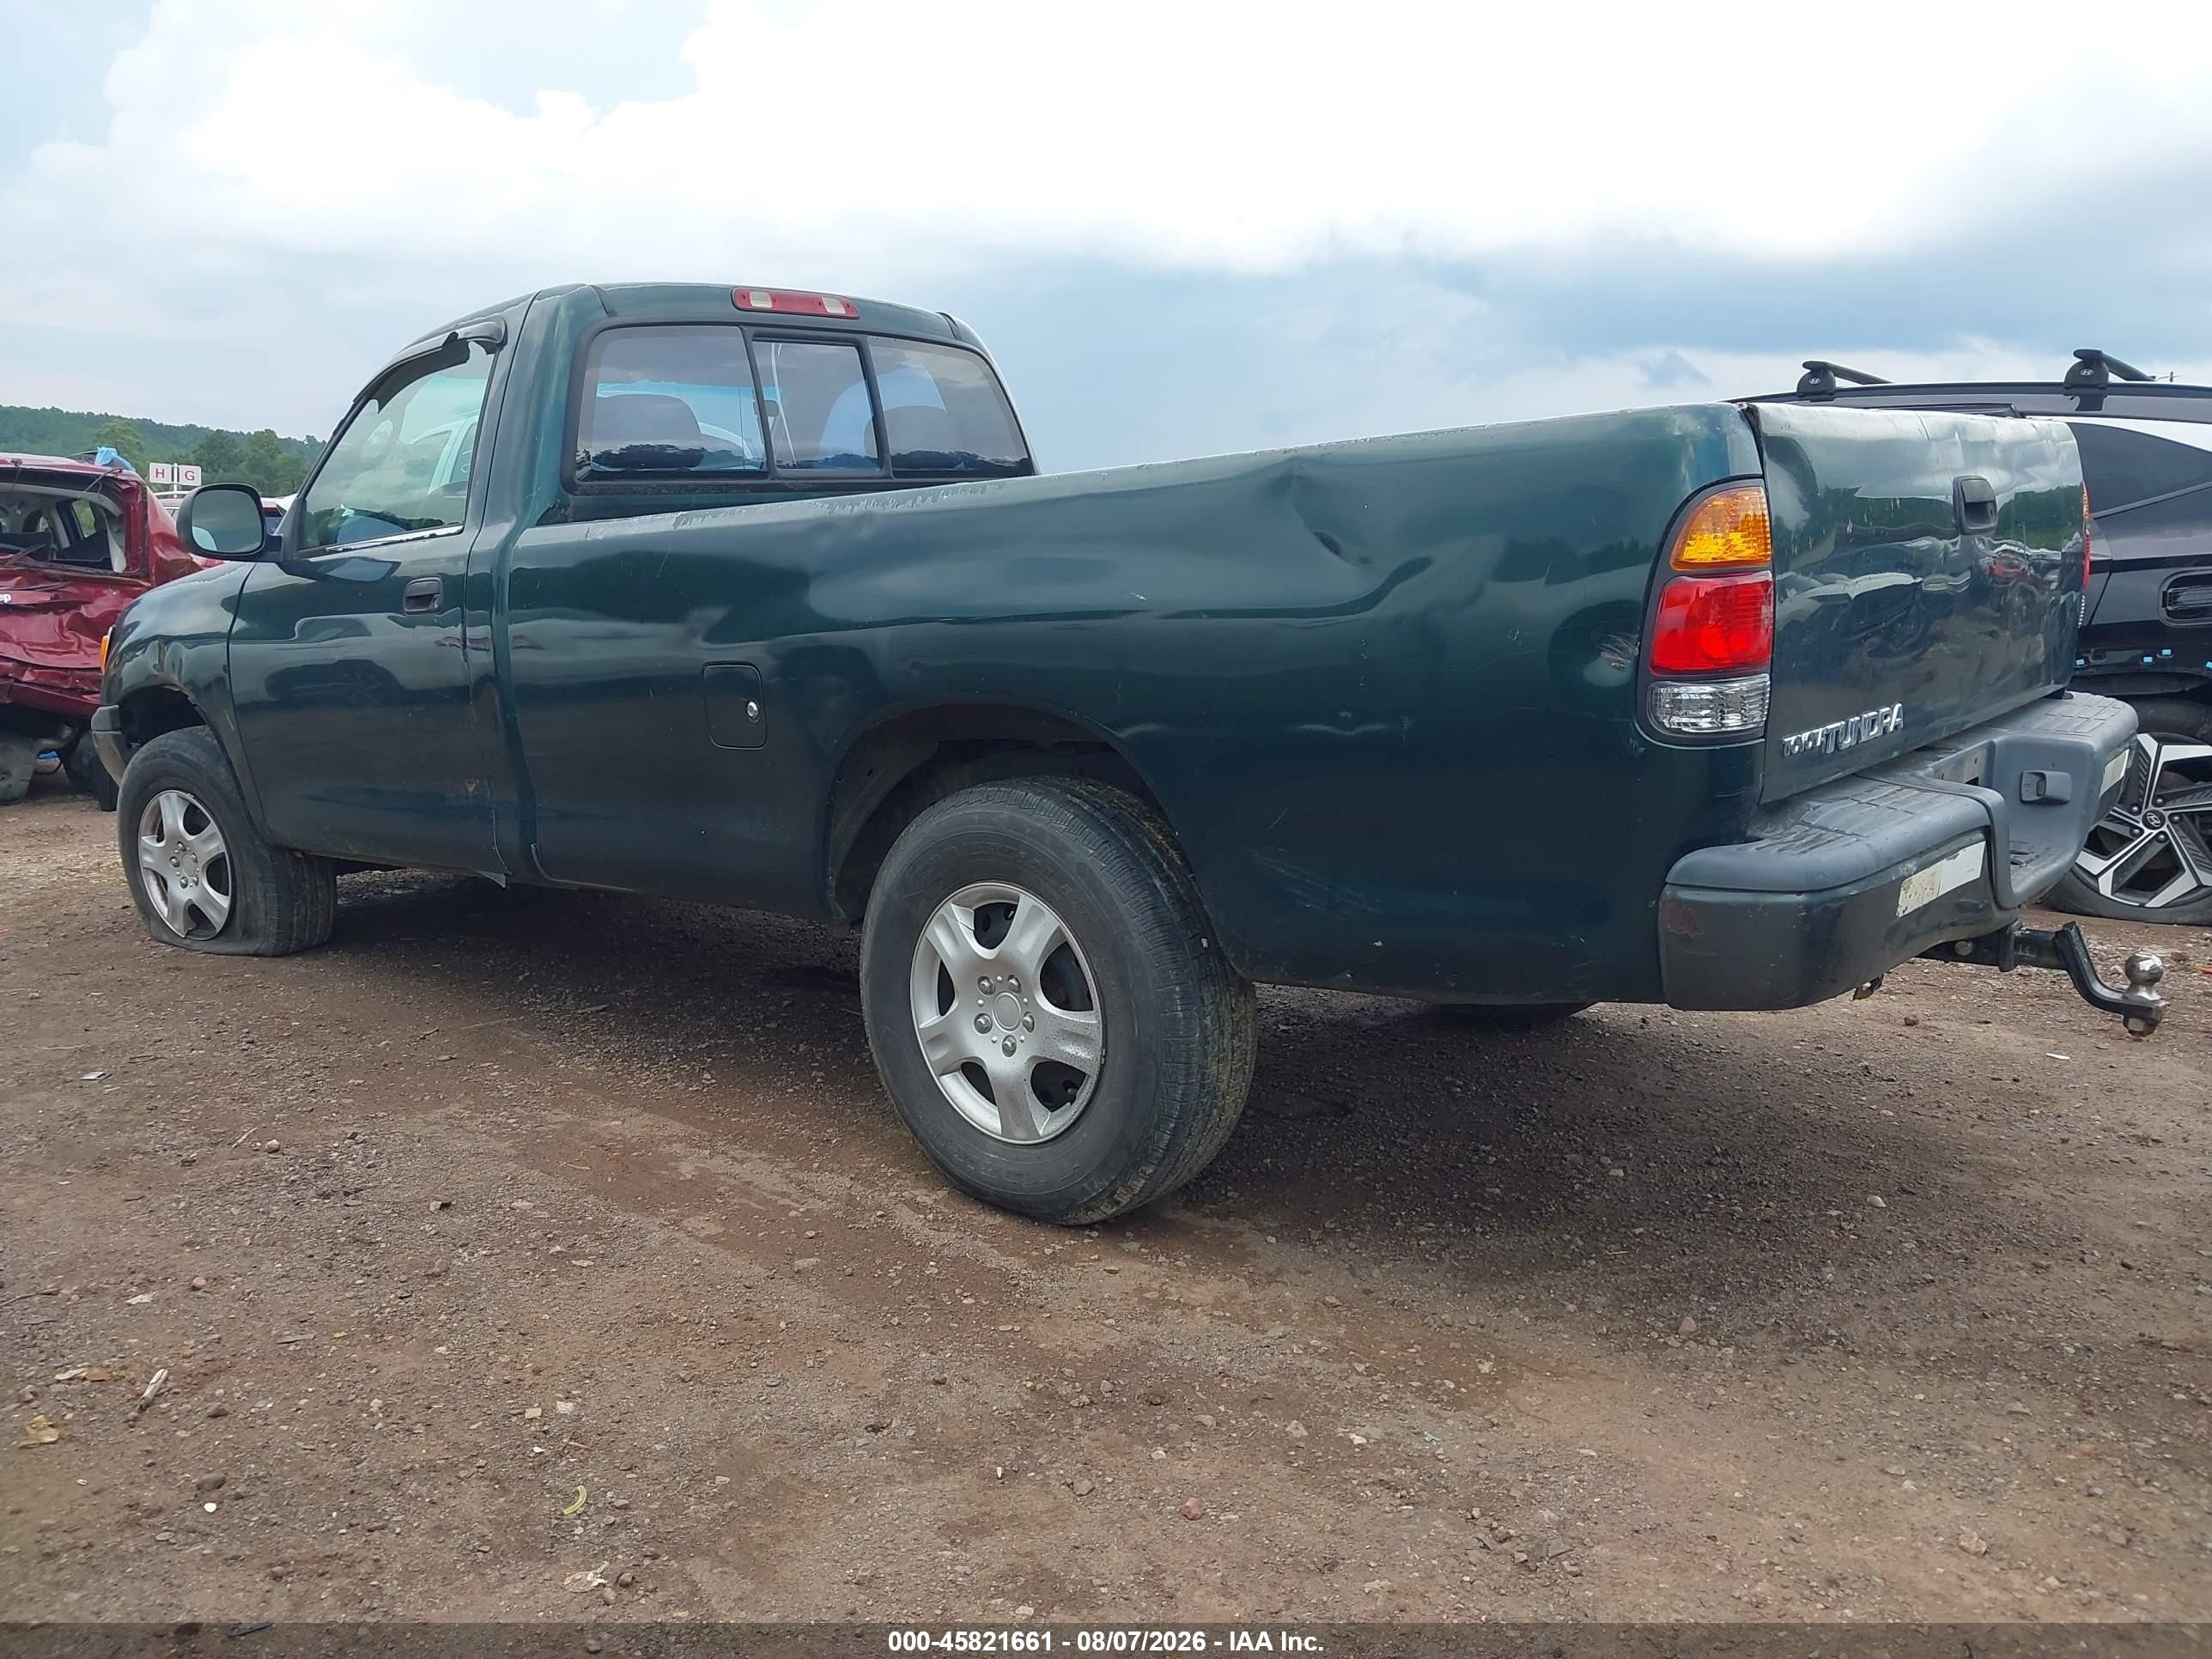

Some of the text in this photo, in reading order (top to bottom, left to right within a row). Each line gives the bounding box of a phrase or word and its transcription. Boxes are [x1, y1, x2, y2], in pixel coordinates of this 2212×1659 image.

[155, 468, 165, 478] H
[185, 470, 195, 481] G
[1825, 702, 1904, 754] TUNDRA
